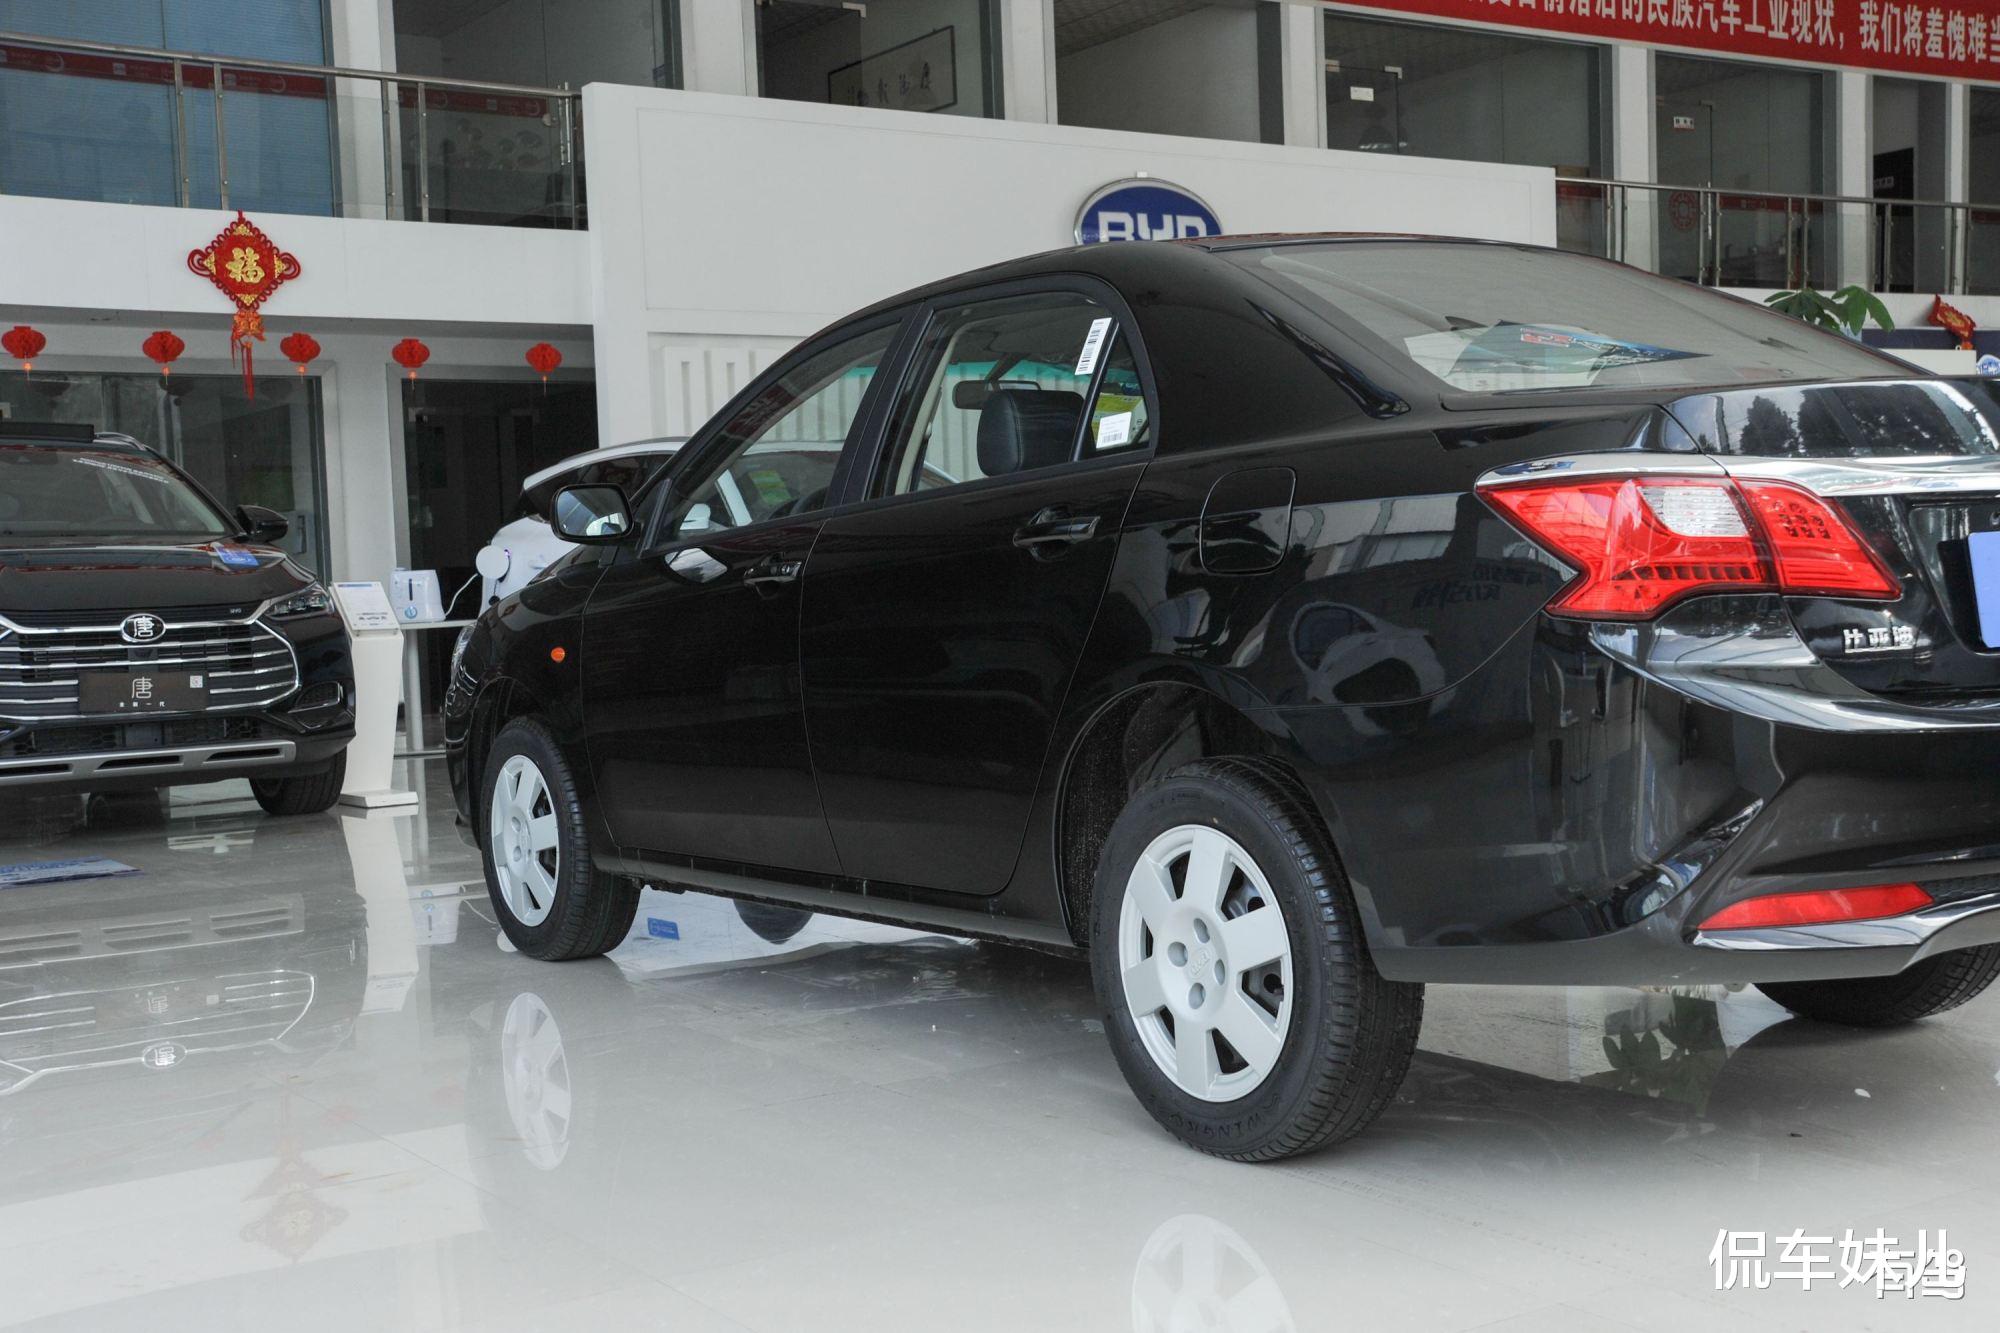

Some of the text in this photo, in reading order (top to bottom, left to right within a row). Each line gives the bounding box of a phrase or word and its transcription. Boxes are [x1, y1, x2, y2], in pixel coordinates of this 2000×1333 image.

[1097, 210, 1208, 242] BYD
[225, 246, 265, 284] 福
[131, 676, 154, 699] 唐
